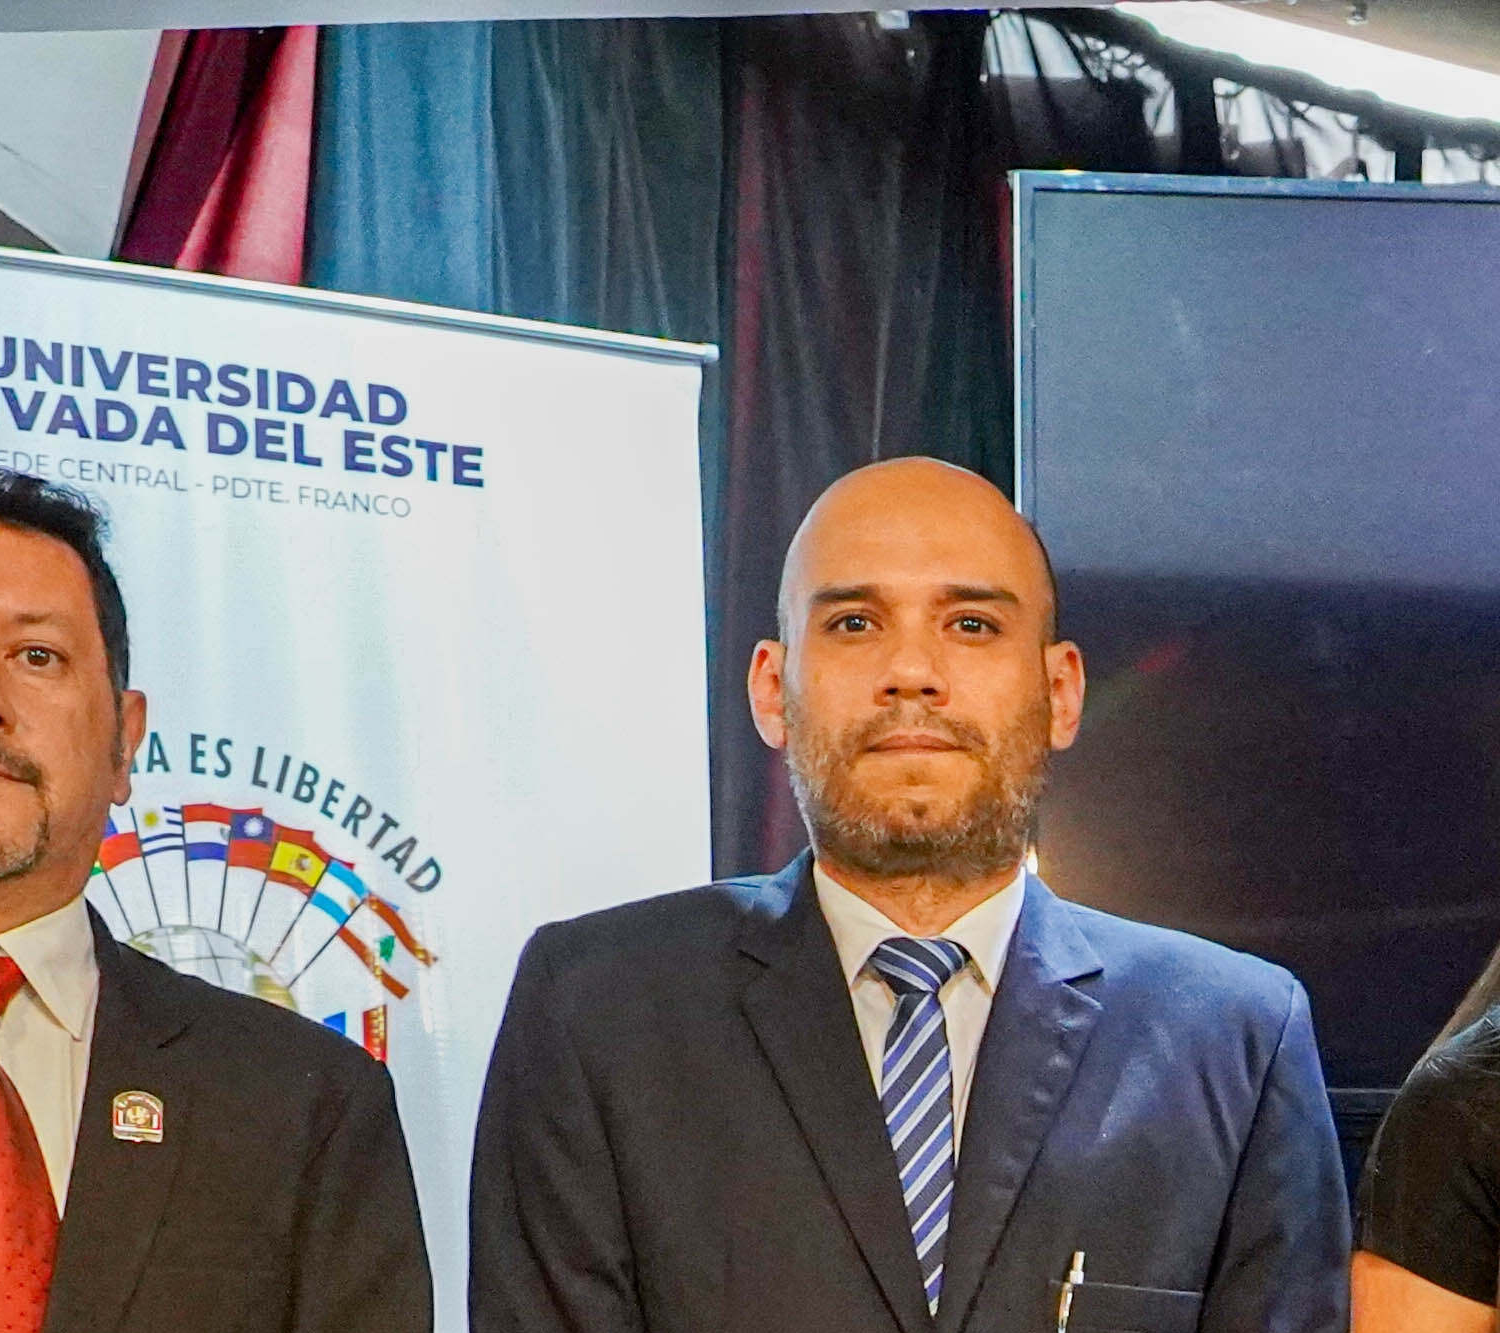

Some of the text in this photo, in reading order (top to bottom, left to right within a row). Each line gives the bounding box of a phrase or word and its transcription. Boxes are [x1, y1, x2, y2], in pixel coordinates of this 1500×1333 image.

[59, 457, 188, 493] CENTRAL
[212, 476, 291, 504] PDTE.
[298, 485, 412, 518] FRANCO
[207, 413, 322, 467] DEL
[343, 430, 485, 488] ESTE
[190, 733, 233, 778] ES
[252, 746, 443, 893] LIBERTAD
